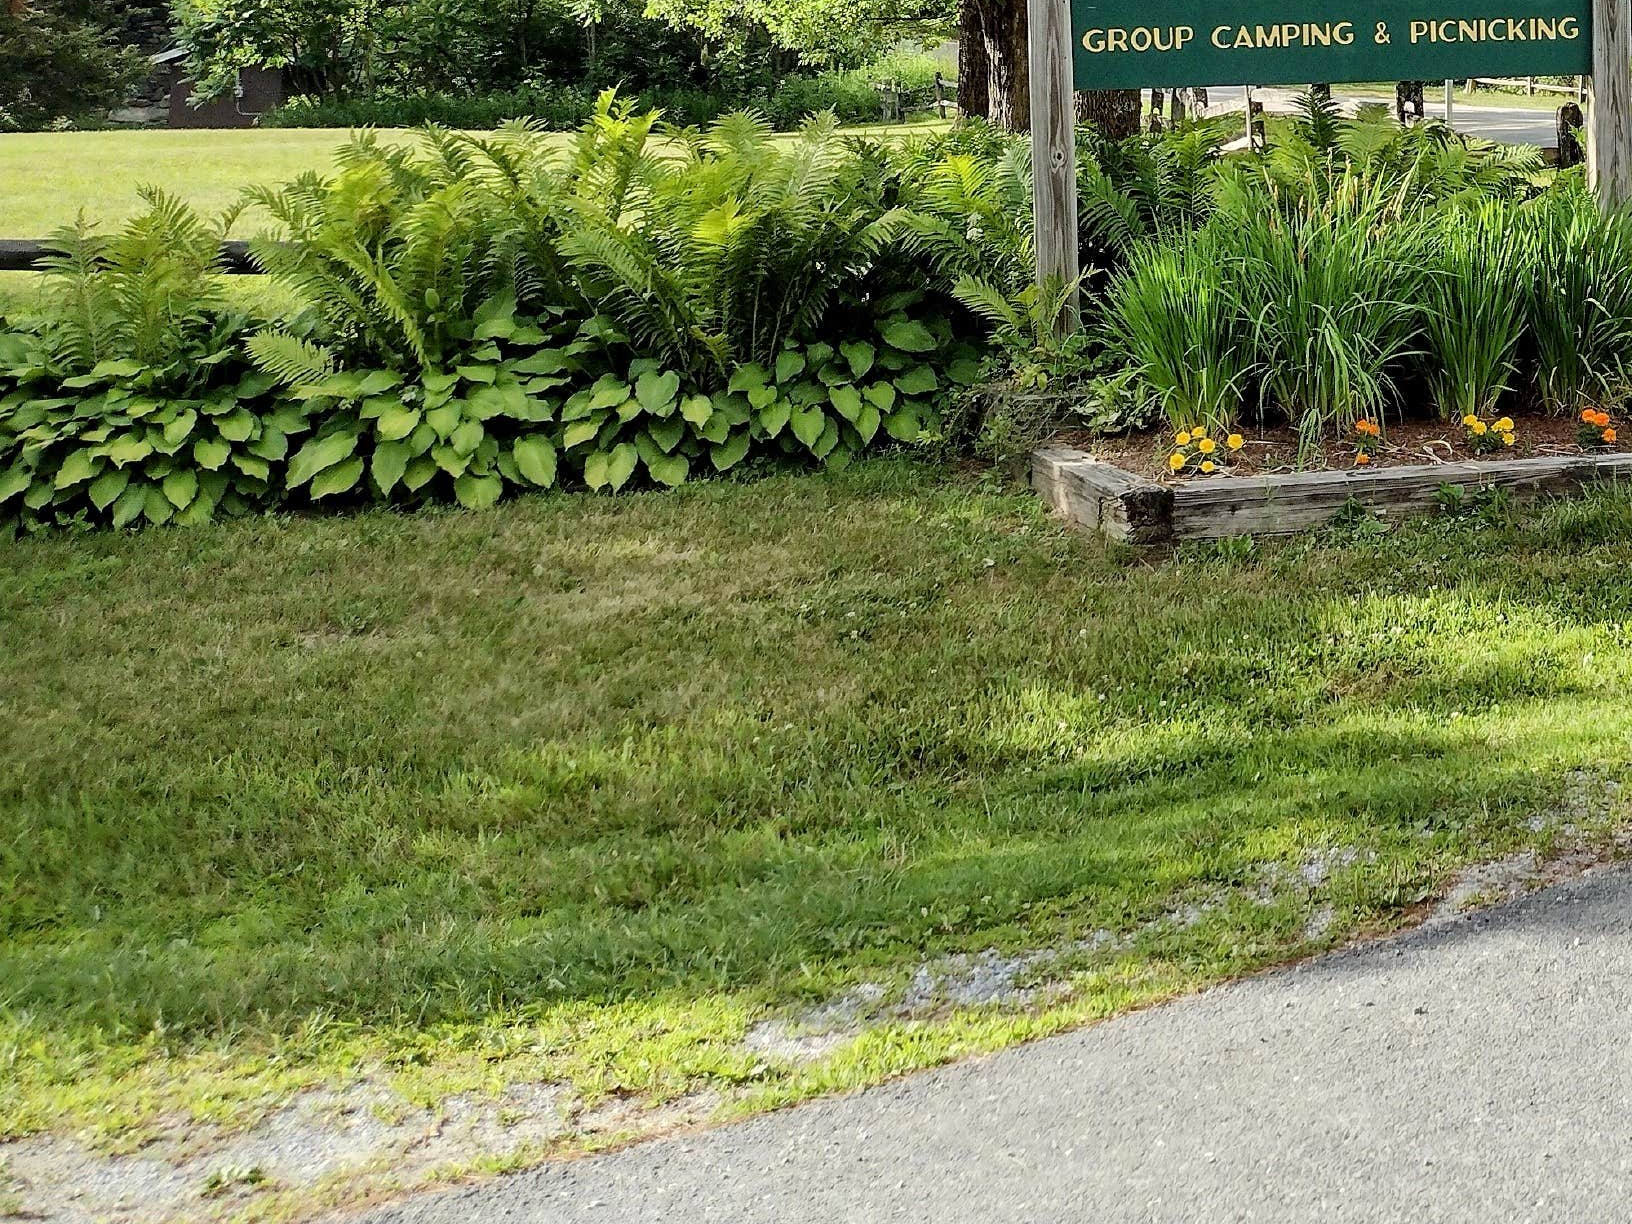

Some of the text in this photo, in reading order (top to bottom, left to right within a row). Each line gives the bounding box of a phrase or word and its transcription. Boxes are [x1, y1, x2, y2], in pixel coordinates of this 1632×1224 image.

[1082, 16, 1579, 53] GROUP CAMPING & PICNICKING
